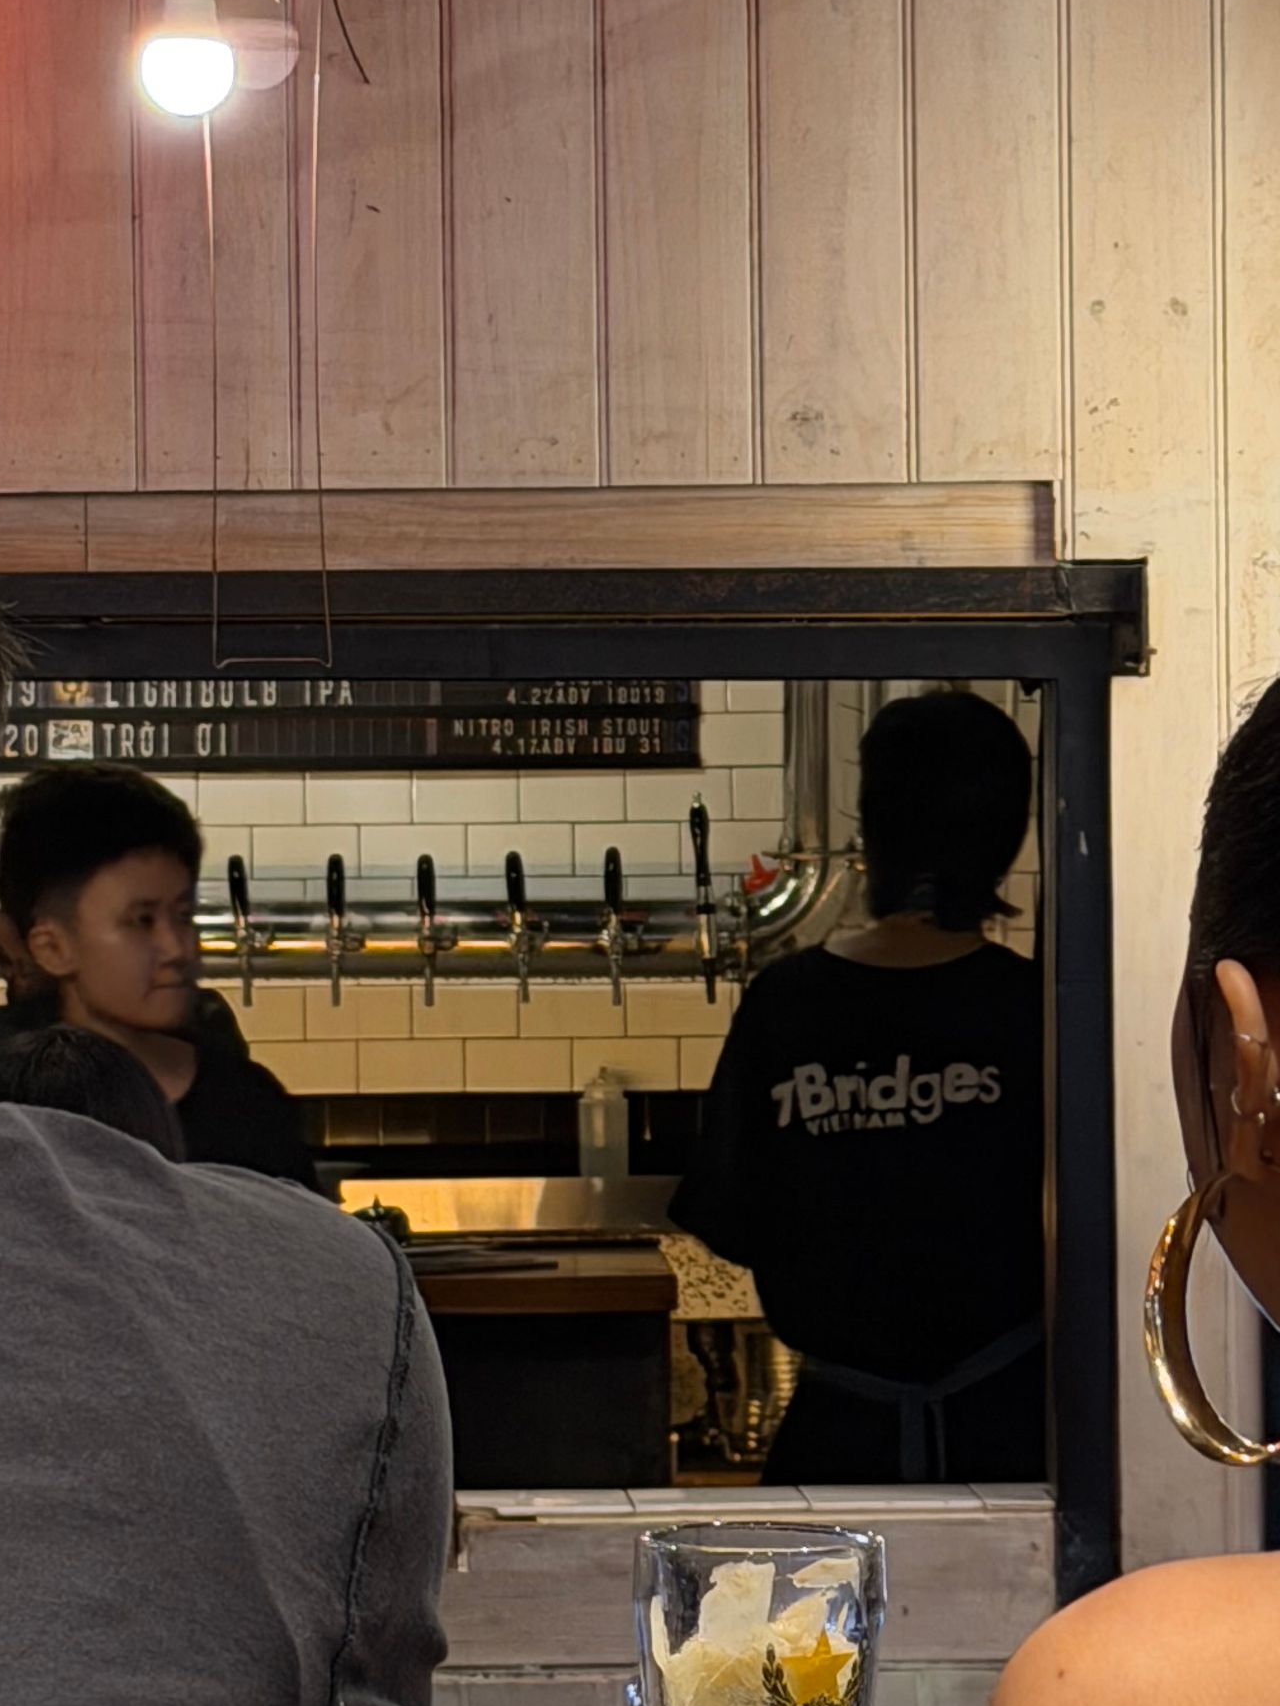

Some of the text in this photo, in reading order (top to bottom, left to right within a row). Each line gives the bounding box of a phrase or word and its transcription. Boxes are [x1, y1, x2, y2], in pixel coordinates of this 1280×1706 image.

[305, 680, 354, 706] IPA
[453, 718, 514, 736] NITRO
[530, 718, 588, 736] IRISH
[602, 717, 662, 735] STOUT
[4, 724, 39, 757] 20
[639, 737, 662, 754] 31
[771, 1054, 1002, 1128] 7Bridges
